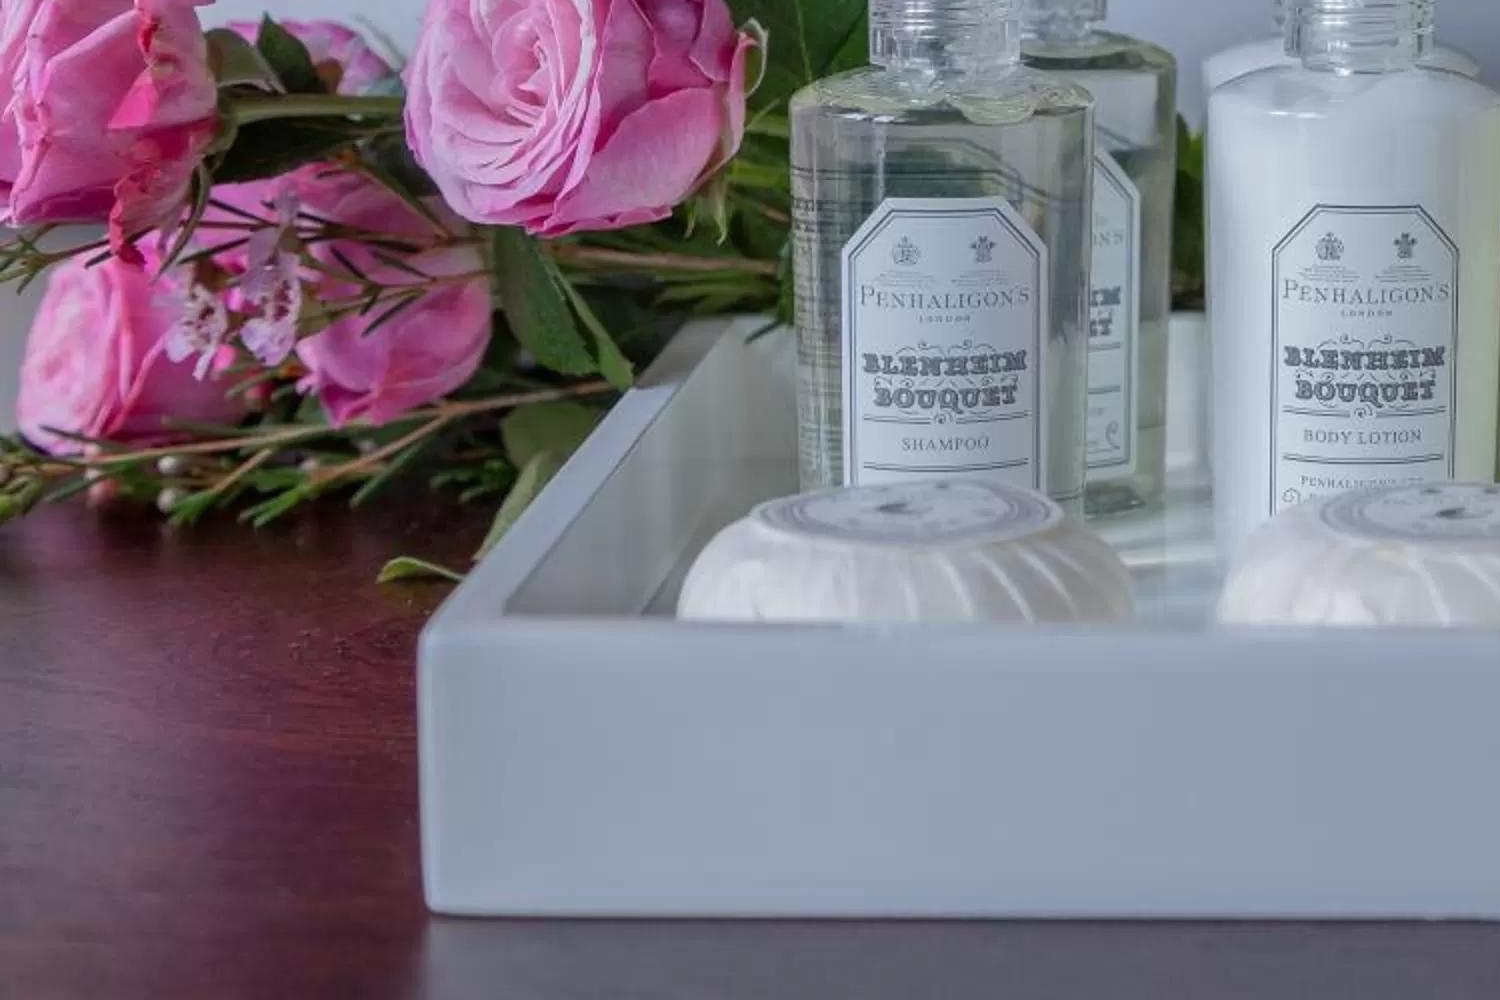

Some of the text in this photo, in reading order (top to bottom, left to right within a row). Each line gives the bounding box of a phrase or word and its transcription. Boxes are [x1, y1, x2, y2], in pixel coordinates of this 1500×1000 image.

[860, 284, 1030, 309] PENHALIGON'S
[1283, 278, 1451, 305] PENHALIGON'S
[862, 350, 1028, 377] BLENHEIM
[1283, 345, 1446, 371] BLENHEIM
[873, 385, 1019, 414] BOUQUET
[1295, 379, 1437, 409] BOUQUET
[901, 435, 990, 451] SHAMPOO
[1303, 428, 1422, 444] BODY LOTION
